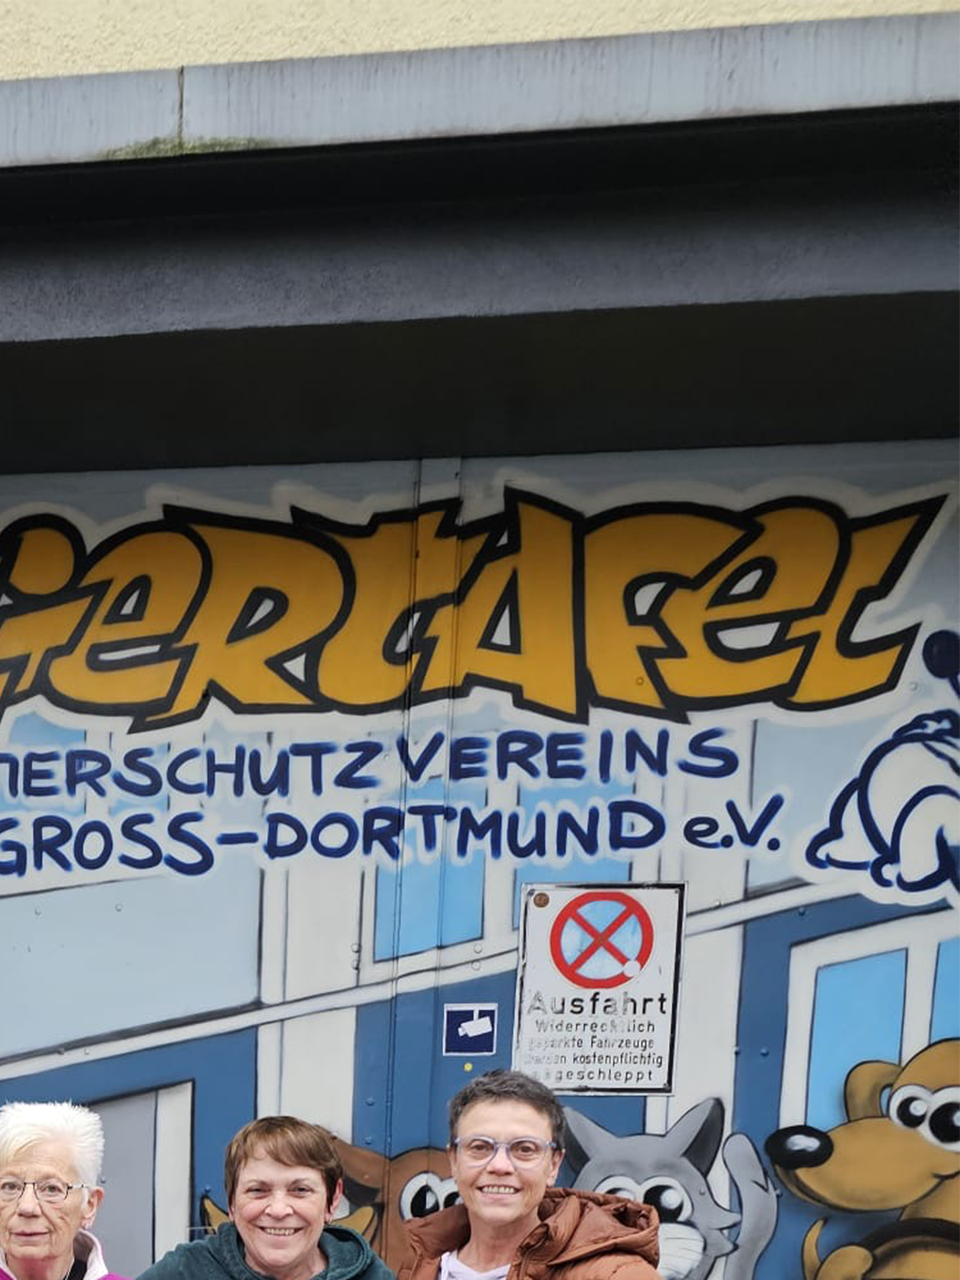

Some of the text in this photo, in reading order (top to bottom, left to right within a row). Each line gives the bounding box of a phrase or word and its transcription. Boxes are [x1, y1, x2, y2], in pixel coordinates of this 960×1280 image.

[692, 795, 781, 853] e.V.
[527, 991, 667, 1015] Ausfahrt
[572, 1052, 664, 1068] kostenpflichtig
[532, 1067, 653, 1083] geschleppt
